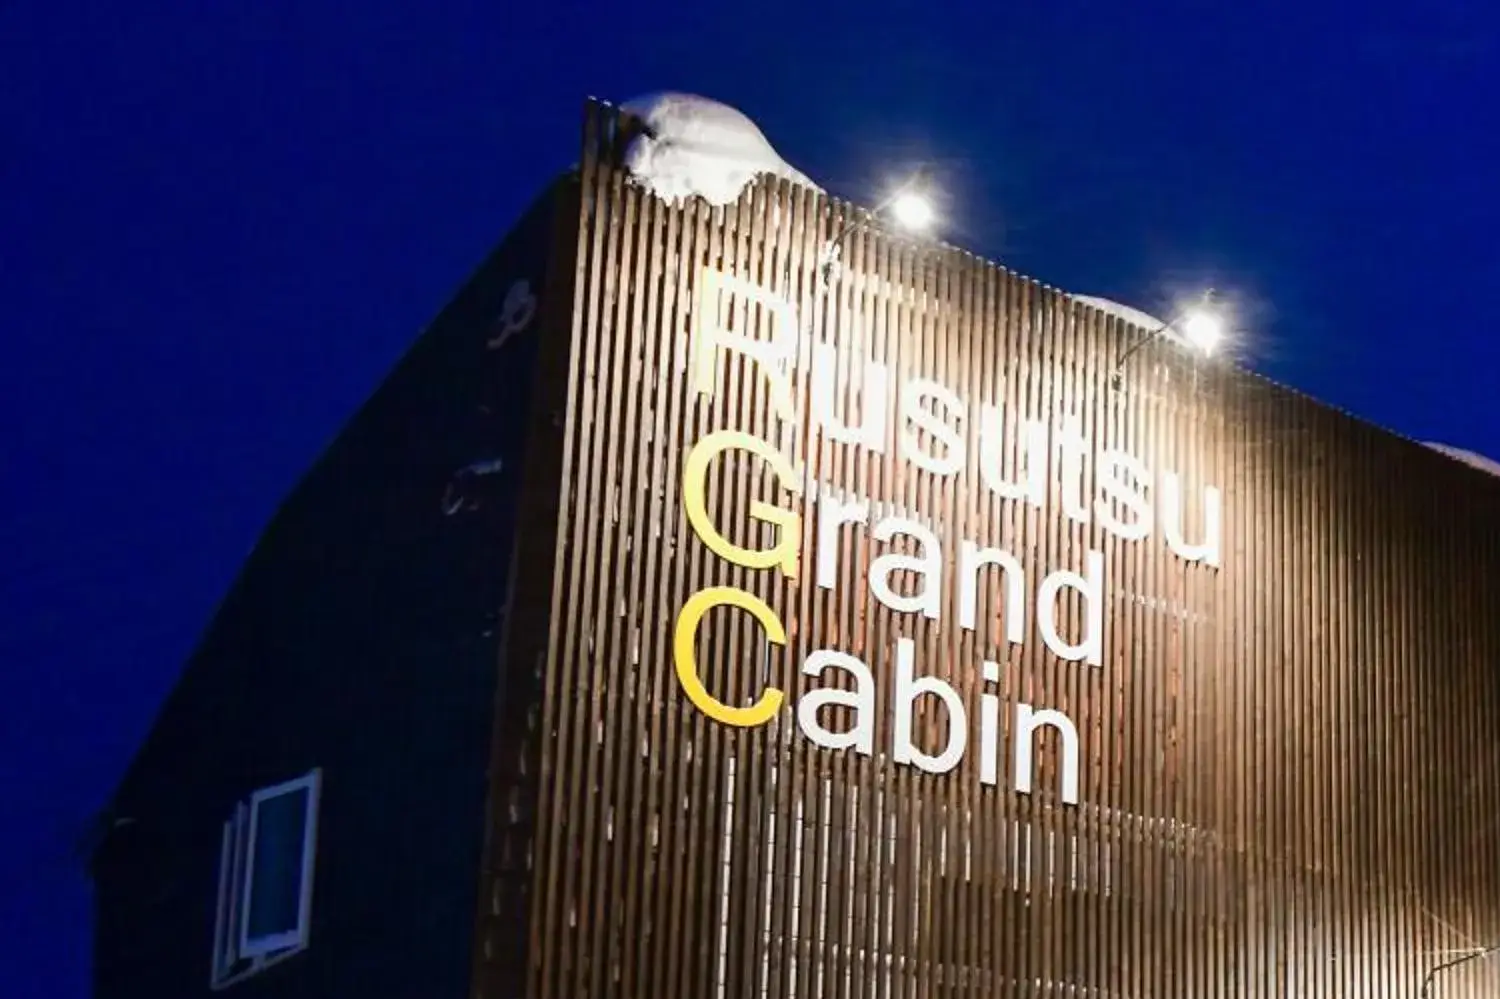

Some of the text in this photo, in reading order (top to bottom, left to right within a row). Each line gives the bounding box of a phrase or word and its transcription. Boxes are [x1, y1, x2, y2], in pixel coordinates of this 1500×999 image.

[693, 265, 1221, 569] Rusutsu
[684, 428, 1104, 668] Grand
[673, 585, 1081, 804] Cabin
